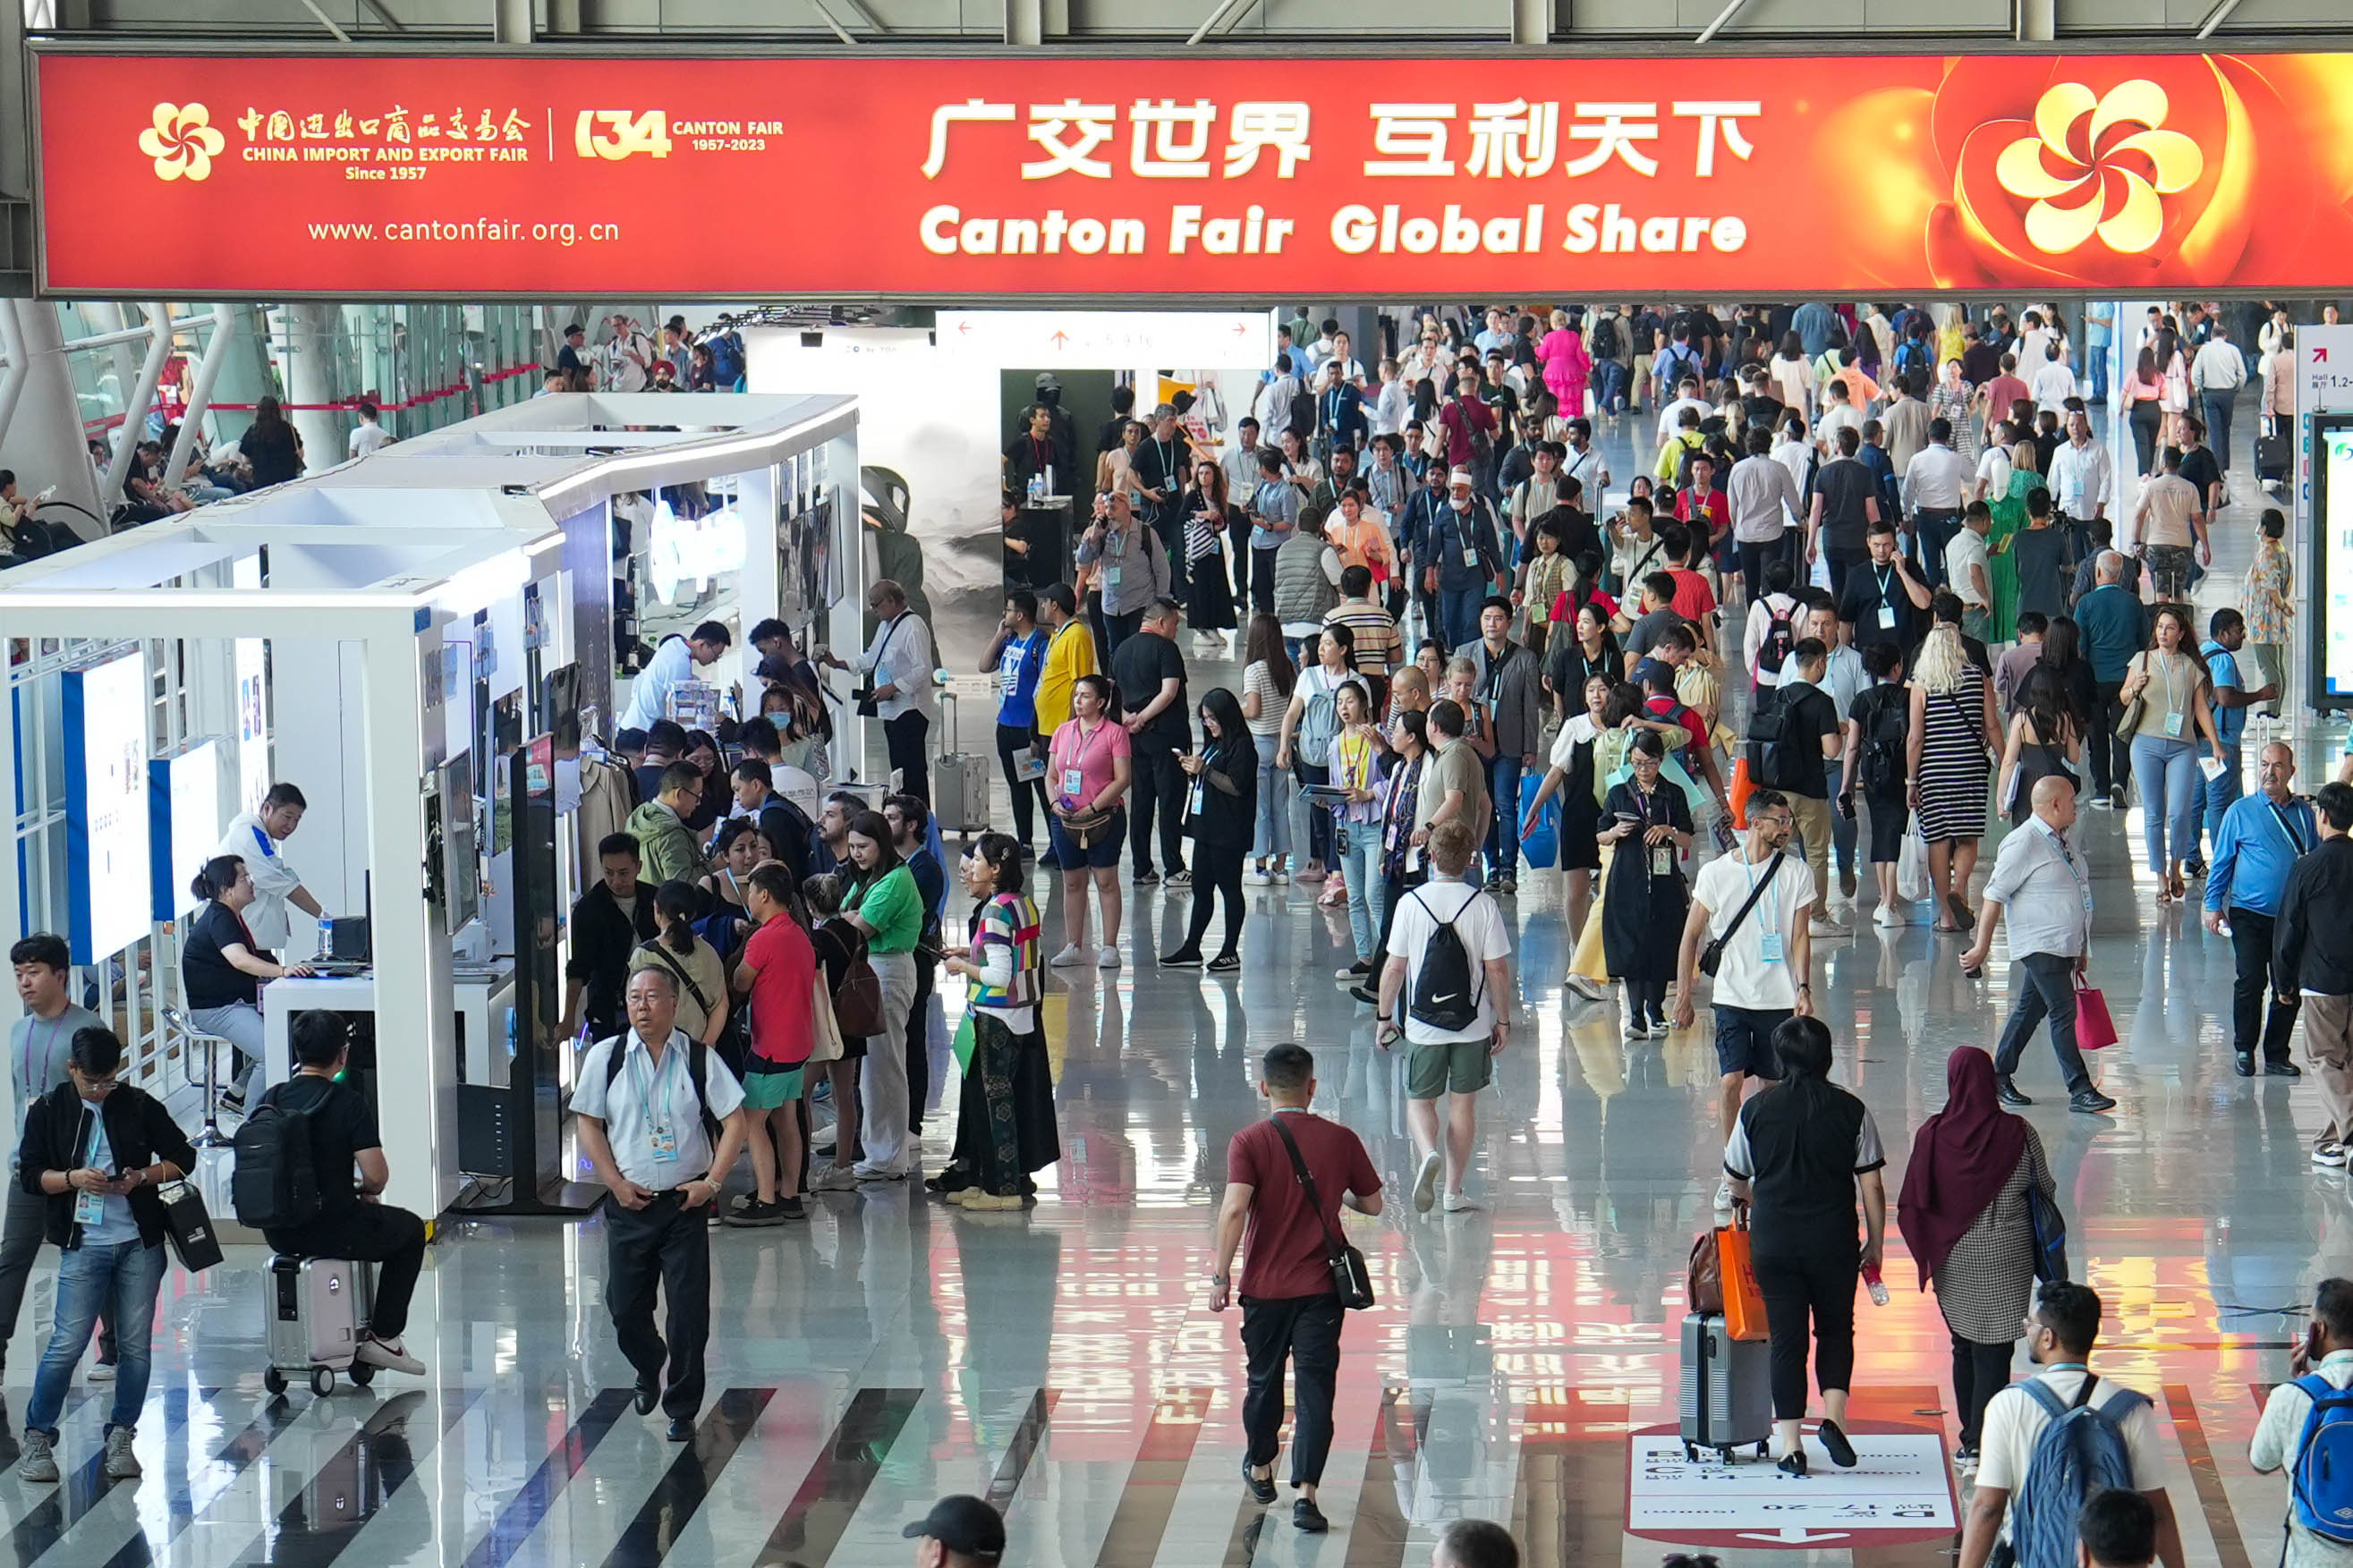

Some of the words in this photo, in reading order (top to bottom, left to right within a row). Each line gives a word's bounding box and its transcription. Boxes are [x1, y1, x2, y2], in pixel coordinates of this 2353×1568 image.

[238, 105, 531, 144] 中国进出口商品交易会
[673, 121, 741, 135] CANTON
[748, 121, 784, 135] FAIR
[575, 110, 671, 159] 134
[921, 97, 1312, 180] 广交世界
[1363, 97, 1762, 179] 互利天下
[692, 139, 766, 151] 1957-2023
[242, 147, 299, 162] CHINA
[302, 147, 371, 162] IMPORT
[375, 147, 414, 162] AND
[419, 147, 485, 162] EXPORT
[489, 147, 529, 162] FAIR
[345, 165, 387, 180] Since
[389, 166, 427, 180] 1957
[919, 204, 1146, 255] Canton
[1168, 204, 1295, 255] Fair
[1330, 204, 1545, 254] Global
[1561, 203, 1747, 254] Share
[1646, 1466, 1686, 1474] C
[1891, 1510, 1935, 1518] D
